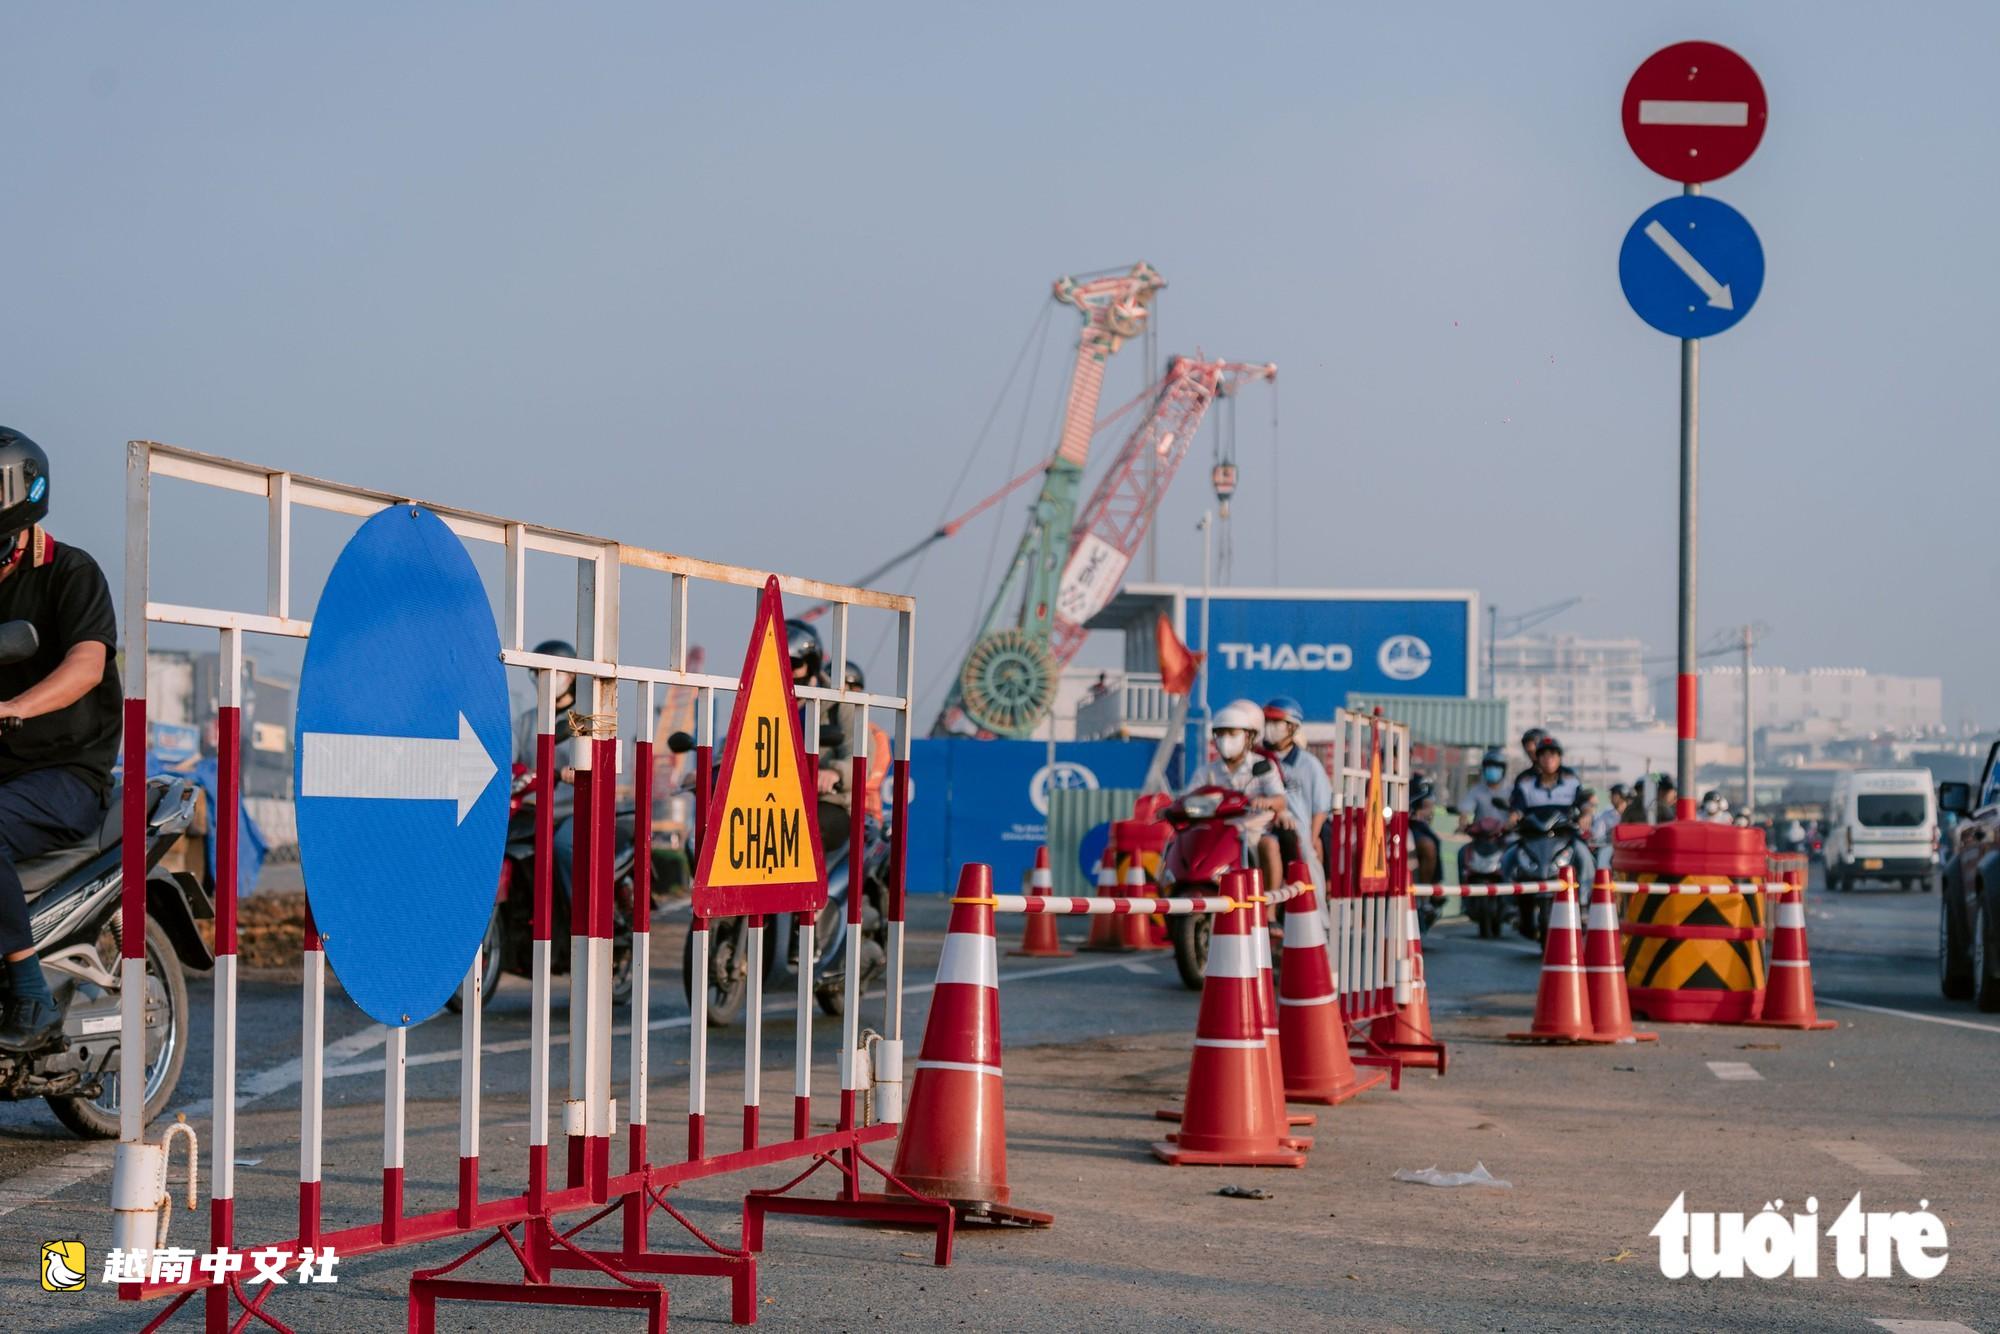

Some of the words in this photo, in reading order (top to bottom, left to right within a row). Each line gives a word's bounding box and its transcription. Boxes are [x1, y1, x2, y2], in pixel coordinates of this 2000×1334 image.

[1218, 643, 1353, 671] THACO
[755, 716, 780, 779] ĐI
[729, 792, 800, 875] CHẬM
